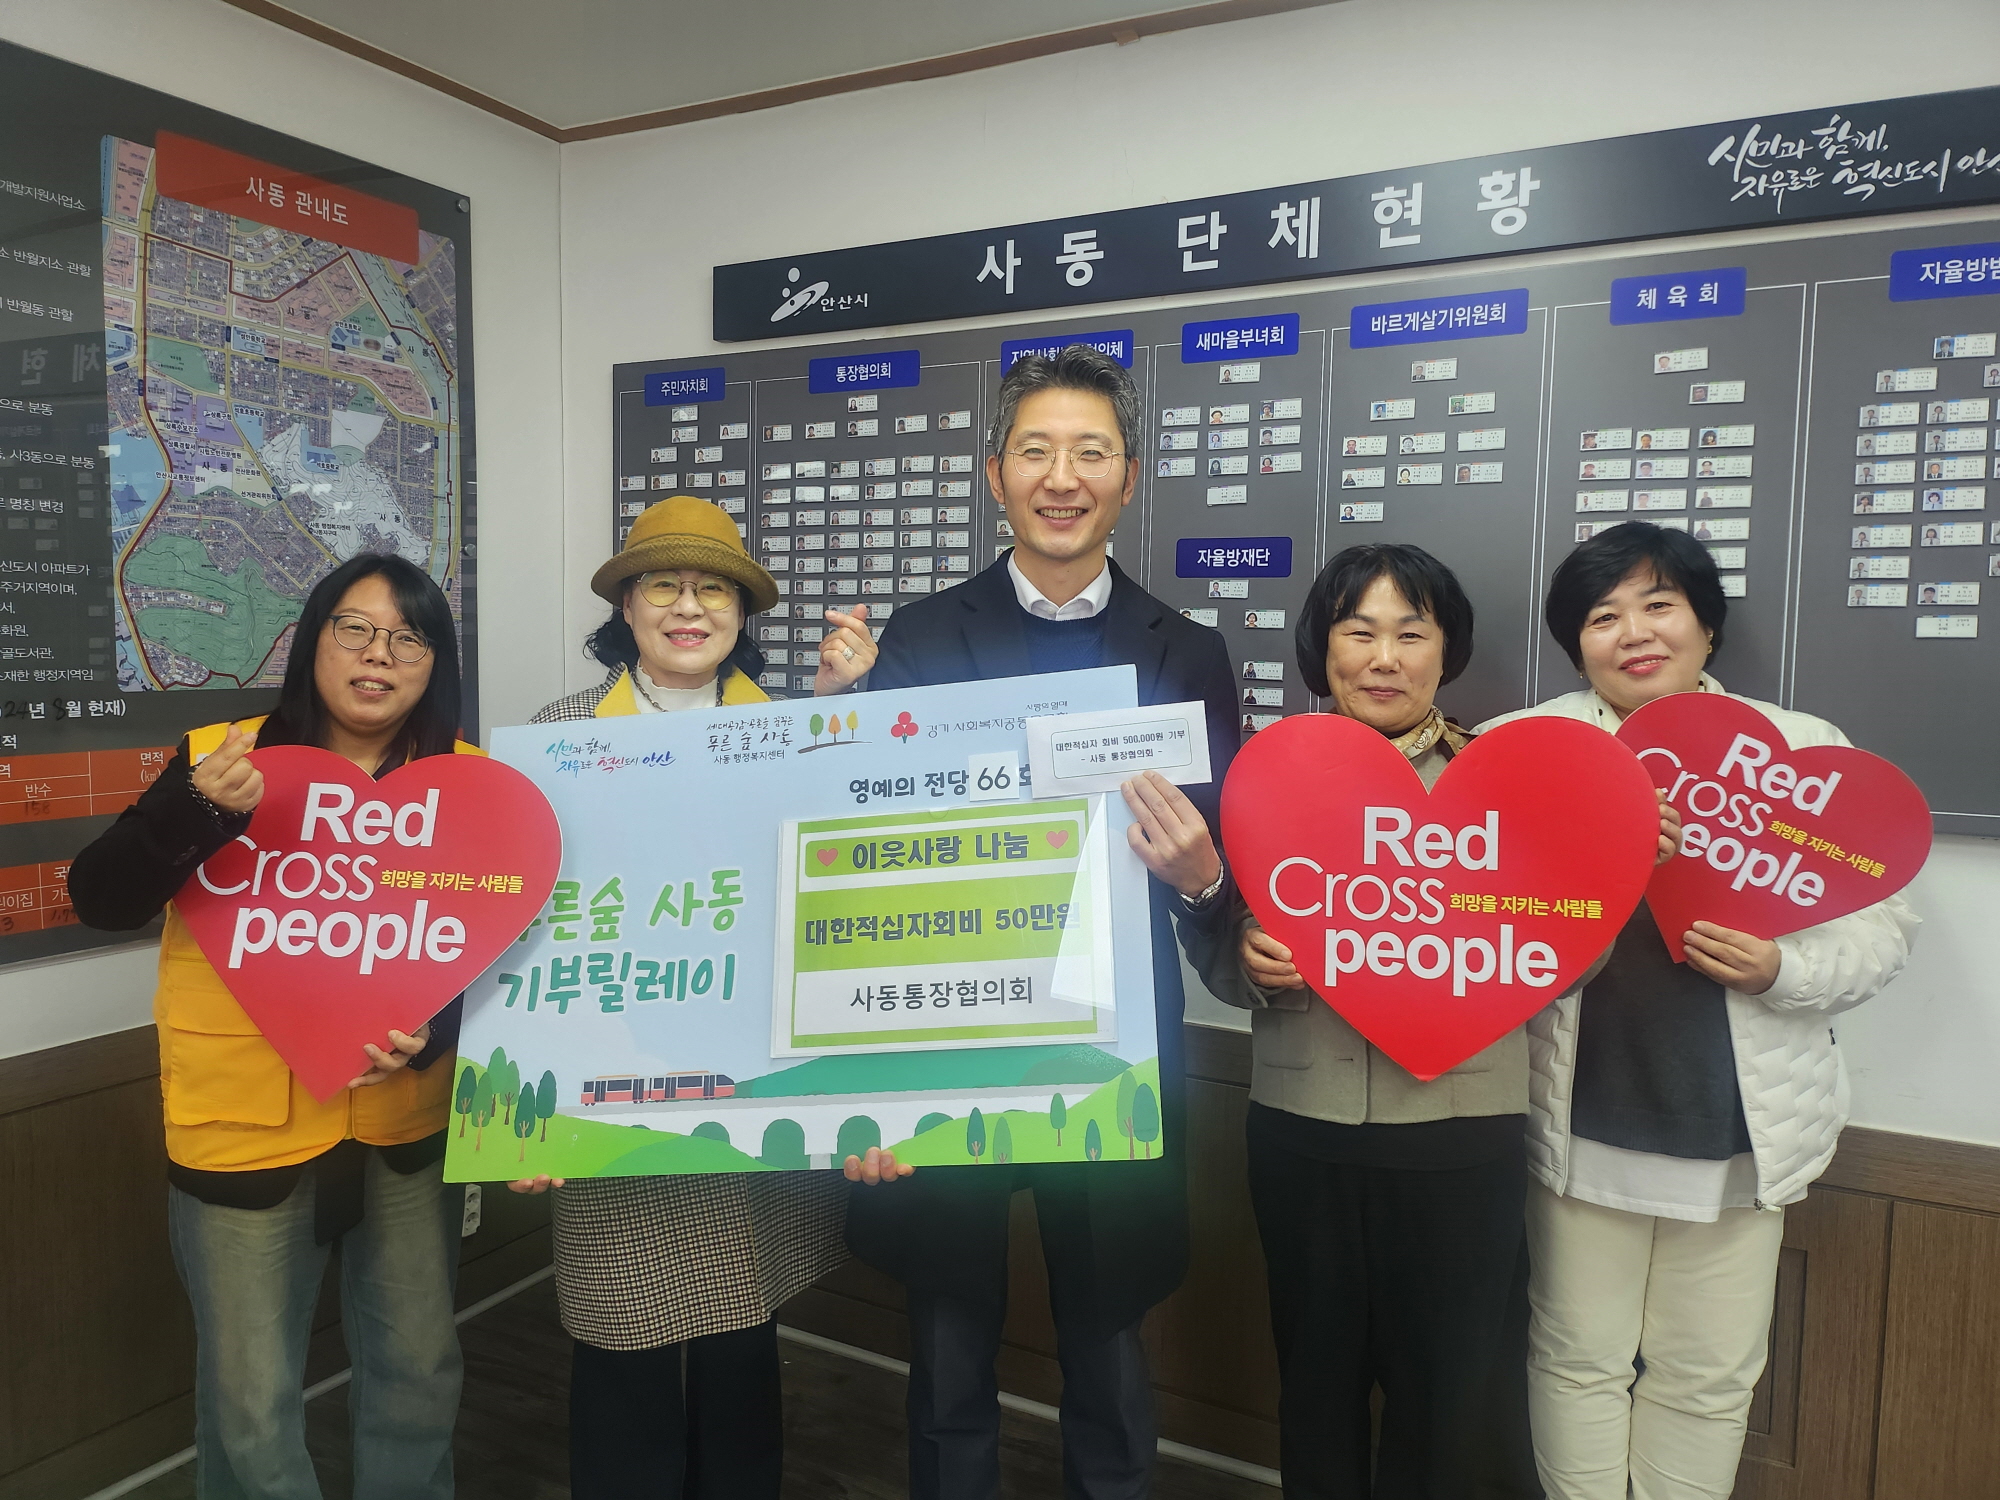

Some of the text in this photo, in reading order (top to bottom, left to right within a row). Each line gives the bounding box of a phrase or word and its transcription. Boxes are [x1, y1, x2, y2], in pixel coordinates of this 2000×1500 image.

[1730, 165, 1825, 214] 자유로운
[1831, 148, 1951, 201] 혁신도시
[245, 177, 350, 226] 사동 관내도
[13, 249, 64, 271] 반월지소
[66, 261, 92, 278] 관할
[6, 298, 45, 317] 반월동
[48, 306, 74, 322] 관할
[820, 292, 868, 312] 안산시
[1371, 303, 1508, 334] 바르게살기위원회
[1196, 324, 1285, 351] 새마을부녀회
[835, 362, 892, 382] 통장협의회
[660, 377, 709, 397] 주민자치회
[28, 401, 54, 416] 분동
[9, 449, 68, 466] 사3동으로
[70, 455, 96, 470] 분동
[9, 497, 35, 511] 명칭
[39, 499, 65, 514] 변경
[0, 560, 90, 576] 신도시 아파트가
[1196, 546, 1270, 568] 자율방재단
[33, 668, 94, 682] 행정지역임
[88, 698, 127, 717] 현재)
[740, 731, 752, 750] 숲
[760, 728, 793, 746] 사동
[926, 723, 949, 738] 경기
[1056, 730, 1185, 752] 대한적십자 회비 500,000원 기부
[140, 751, 164, 766] 면적
[546, 739, 584, 762] 시민과
[556, 750, 676, 778] 자유로운 혁신도시 안산
[714, 749, 785, 764] 사동 행정복지센터
[1090, 753, 1106, 763] 사동
[1111, 748, 1154, 762] 통장협의회
[849, 777, 915, 804] 영예의
[924, 769, 969, 797] 전당
[977, 765, 1011, 791] 66
[1716, 732, 1843, 817] Red
[25, 783, 52, 799] 반수
[300, 782, 441, 848] Red
[852, 831, 1030, 870] 이웃사랑 나눔
[1363, 806, 1499, 871] Red
[1768, 819, 1887, 879] 희망을 지키는 사람들
[53, 866, 69, 884] 국
[196, 835, 379, 902] Cross
[1679, 822, 1826, 907] eople
[379, 868, 524, 894] 희망을 지키는 사람들
[1268, 856, 1446, 926] Cross
[649, 869, 744, 932] 사동
[1449, 893, 1604, 920] 희망을 지키는 사람들
[228, 899, 467, 976] people
[805, 902, 1081, 946] 대한적십자회비 50만원
[1324, 924, 1559, 998] people
[498, 951, 736, 1015] 기부릴레이
[850, 976, 1033, 1013] 사동통장협의회
